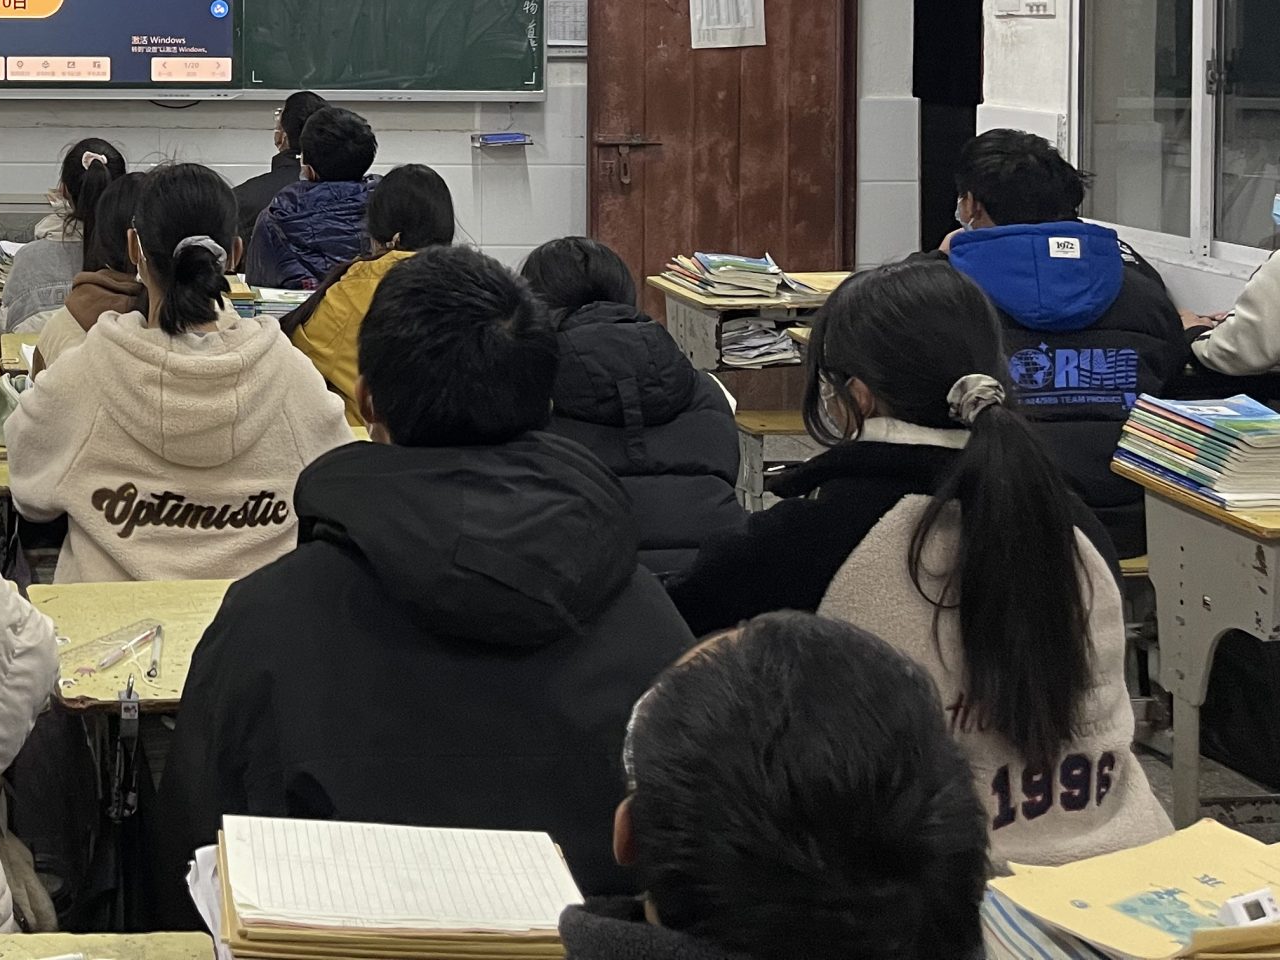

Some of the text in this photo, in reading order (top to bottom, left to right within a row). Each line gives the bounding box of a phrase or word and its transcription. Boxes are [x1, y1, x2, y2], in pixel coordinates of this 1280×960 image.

[150, 36, 186, 44] Windows
[1056, 241, 1075, 250] 1972
[91, 482, 289, 538] Optimistic
